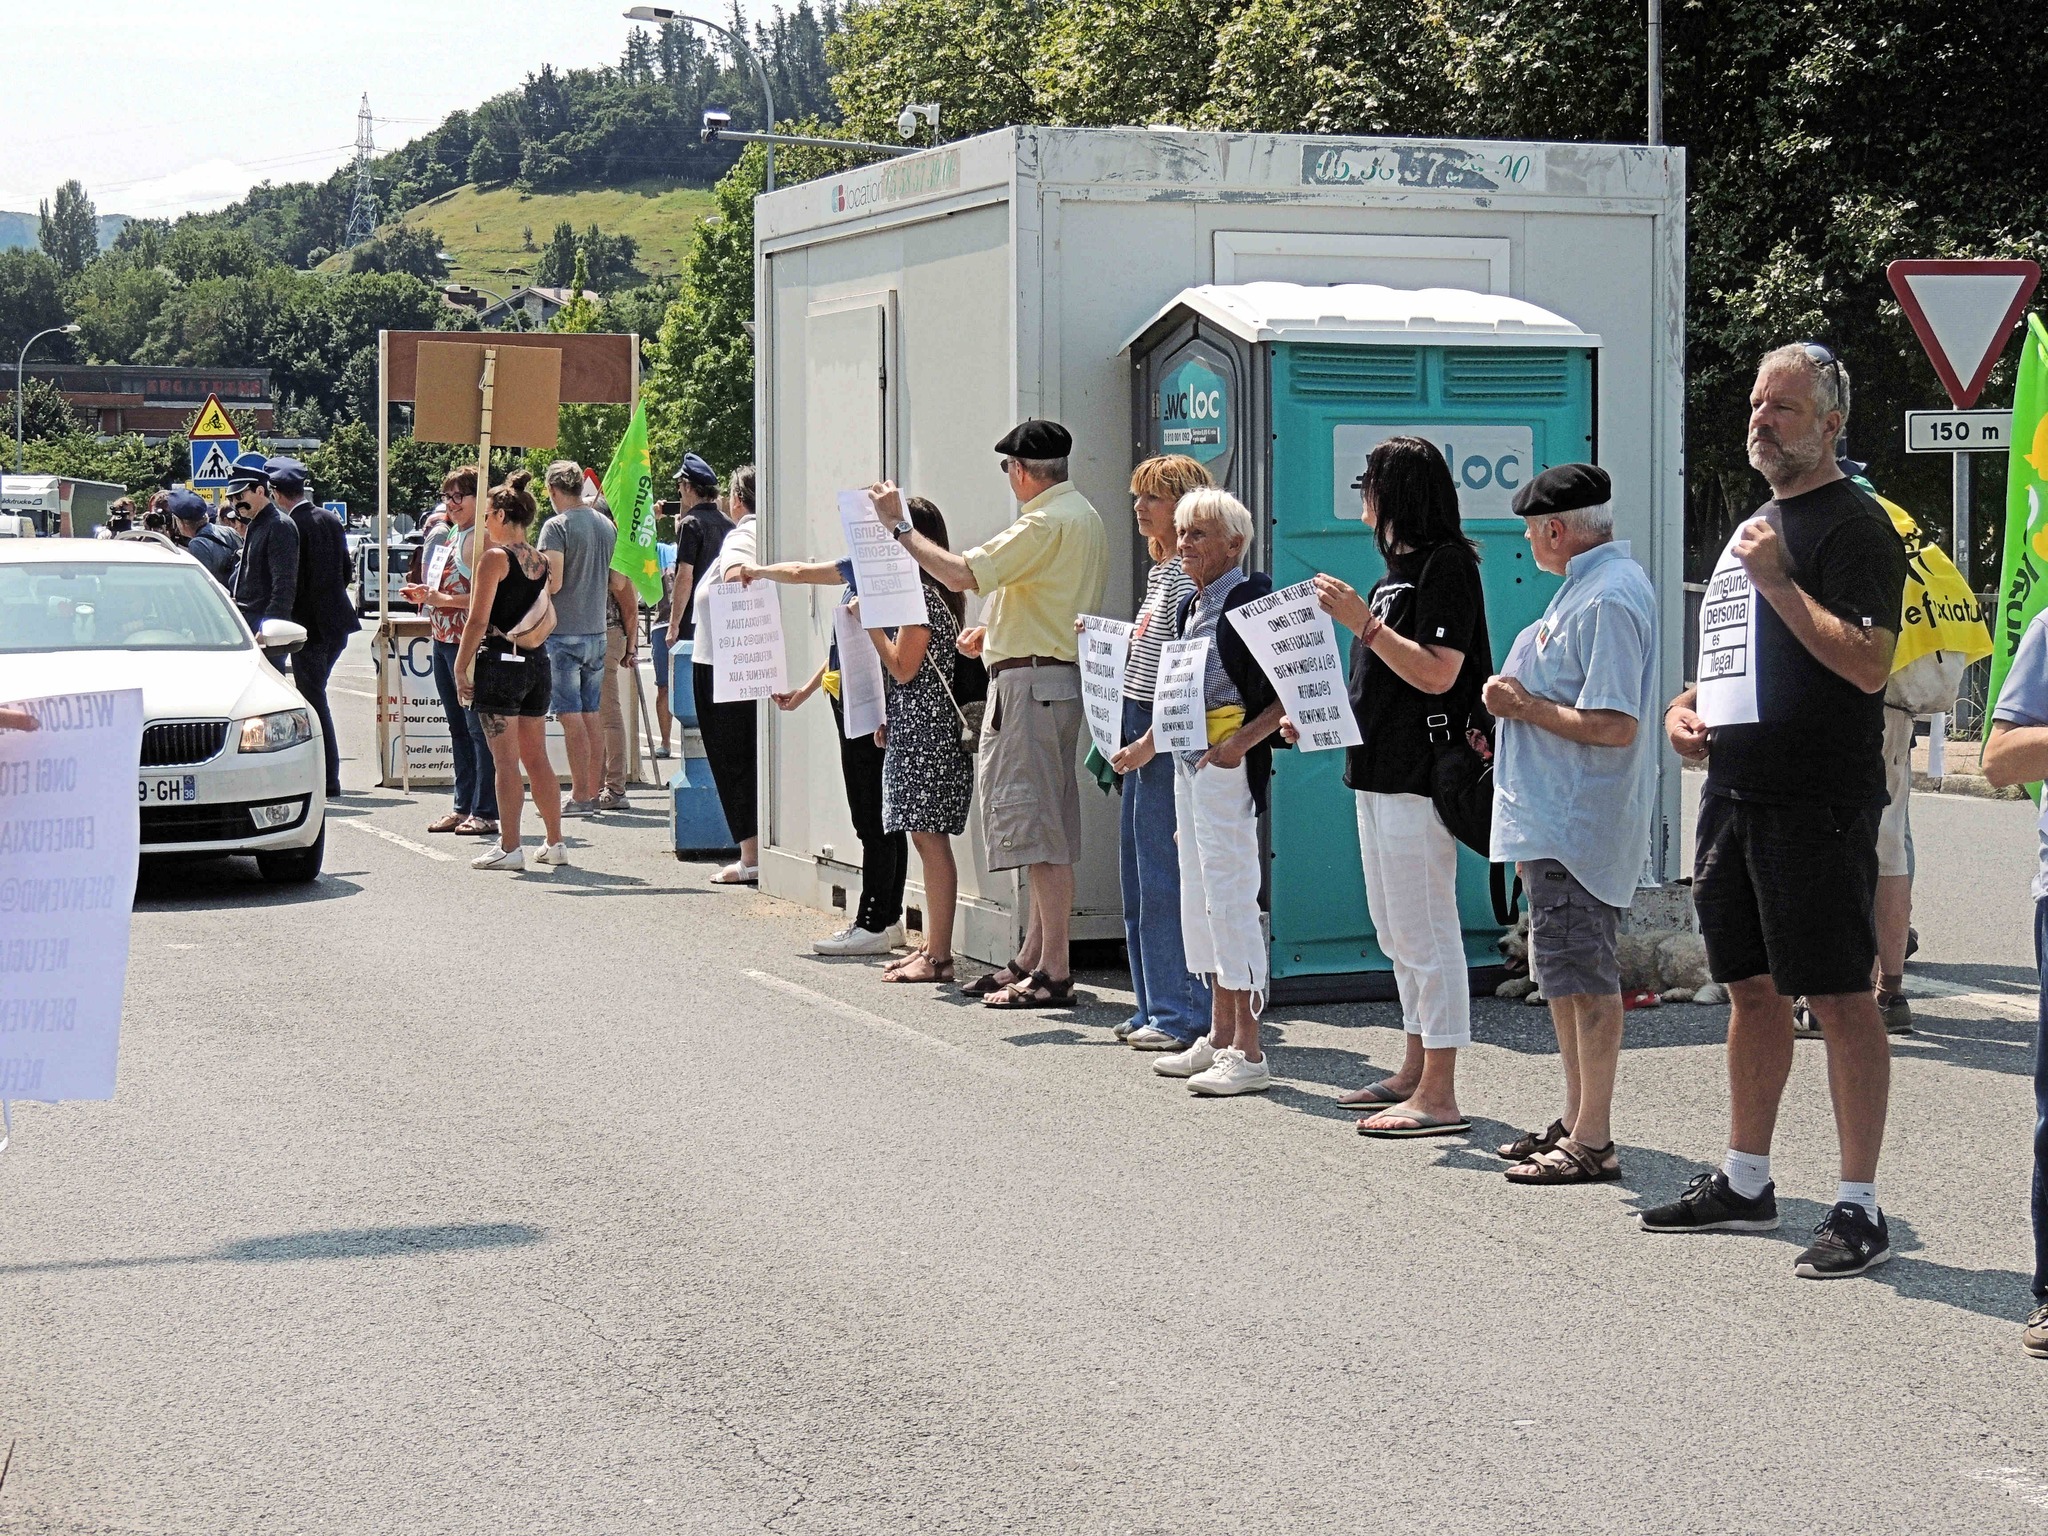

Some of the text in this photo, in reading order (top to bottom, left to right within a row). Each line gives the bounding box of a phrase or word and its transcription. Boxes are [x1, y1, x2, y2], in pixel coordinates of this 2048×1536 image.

[1930, 421, 1999, 441] 150 m
[1709, 573, 1748, 600] ninguna
[1238, 581, 1317, 620] WELCOME REFUGEE
[1267, 606, 1316, 633] ONGI ETORRI
[1706, 602, 1746, 630] persona
[1712, 633, 1720, 646] es
[1710, 649, 1735, 674] ilegal
[412, 697, 428, 708] qui
[1329, 706, 1341, 720] AUX
[184, 789, 195, 799] 38
